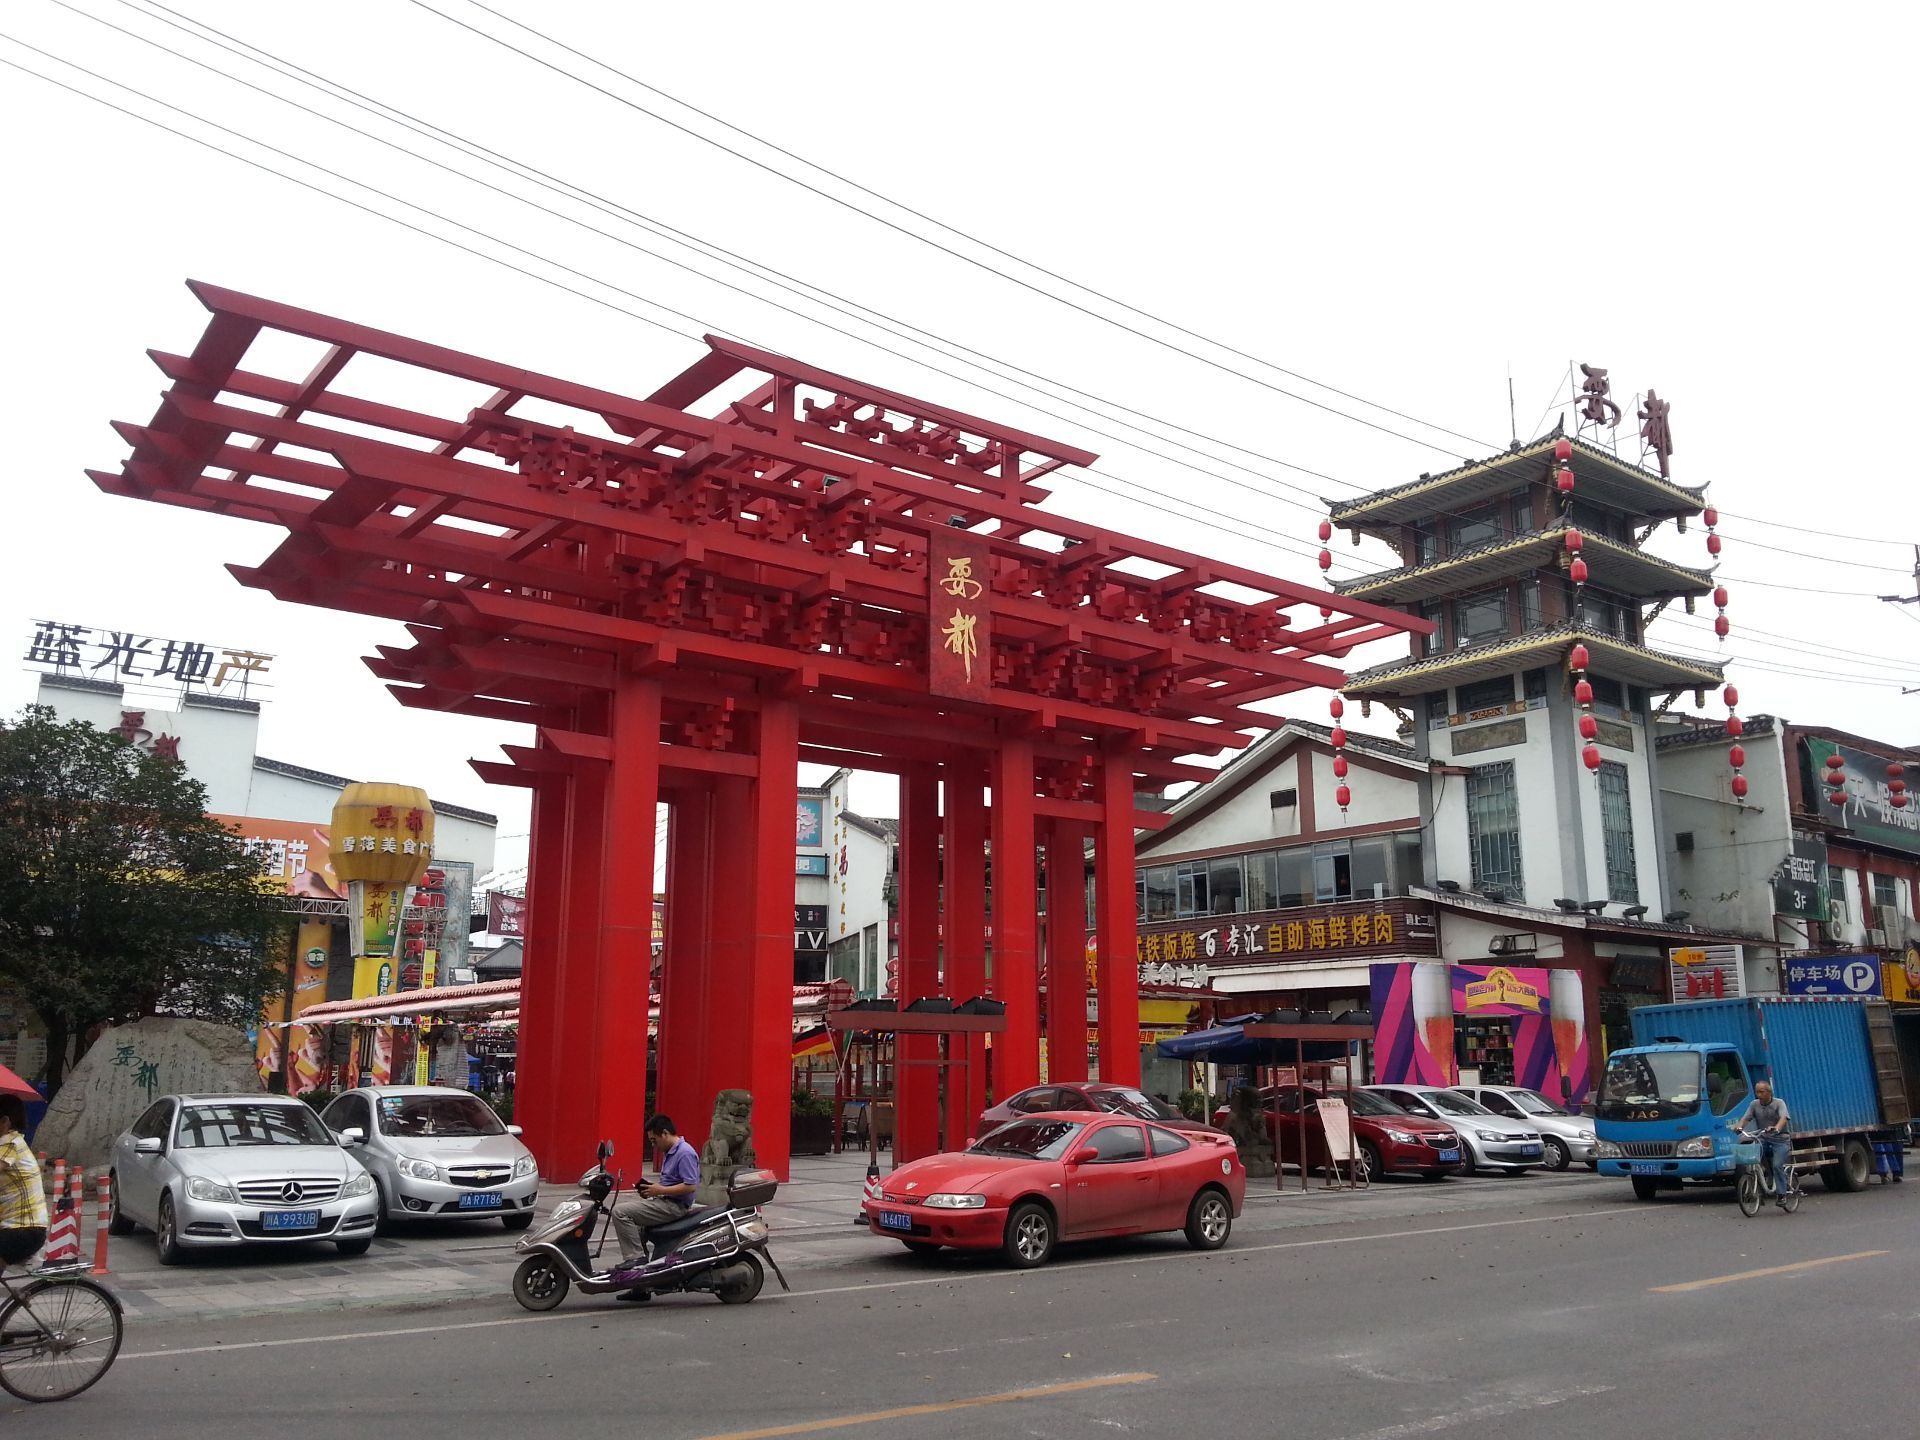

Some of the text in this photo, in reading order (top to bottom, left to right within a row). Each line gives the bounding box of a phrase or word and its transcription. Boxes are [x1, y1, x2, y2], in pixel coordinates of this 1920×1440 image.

[940, 557, 982, 684] 耍都
[23, 621, 273, 686] 蓝光地产
[1793, 890, 1807, 910] 3F
[1267, 911, 1394, 953] 自助海鲜烤肉
[1138, 961, 1209, 988] 美食广场
[1789, 965, 1841, 982] 停车场
[1850, 966, 1868, 988] P
[1626, 1110, 1660, 1120] JAC
